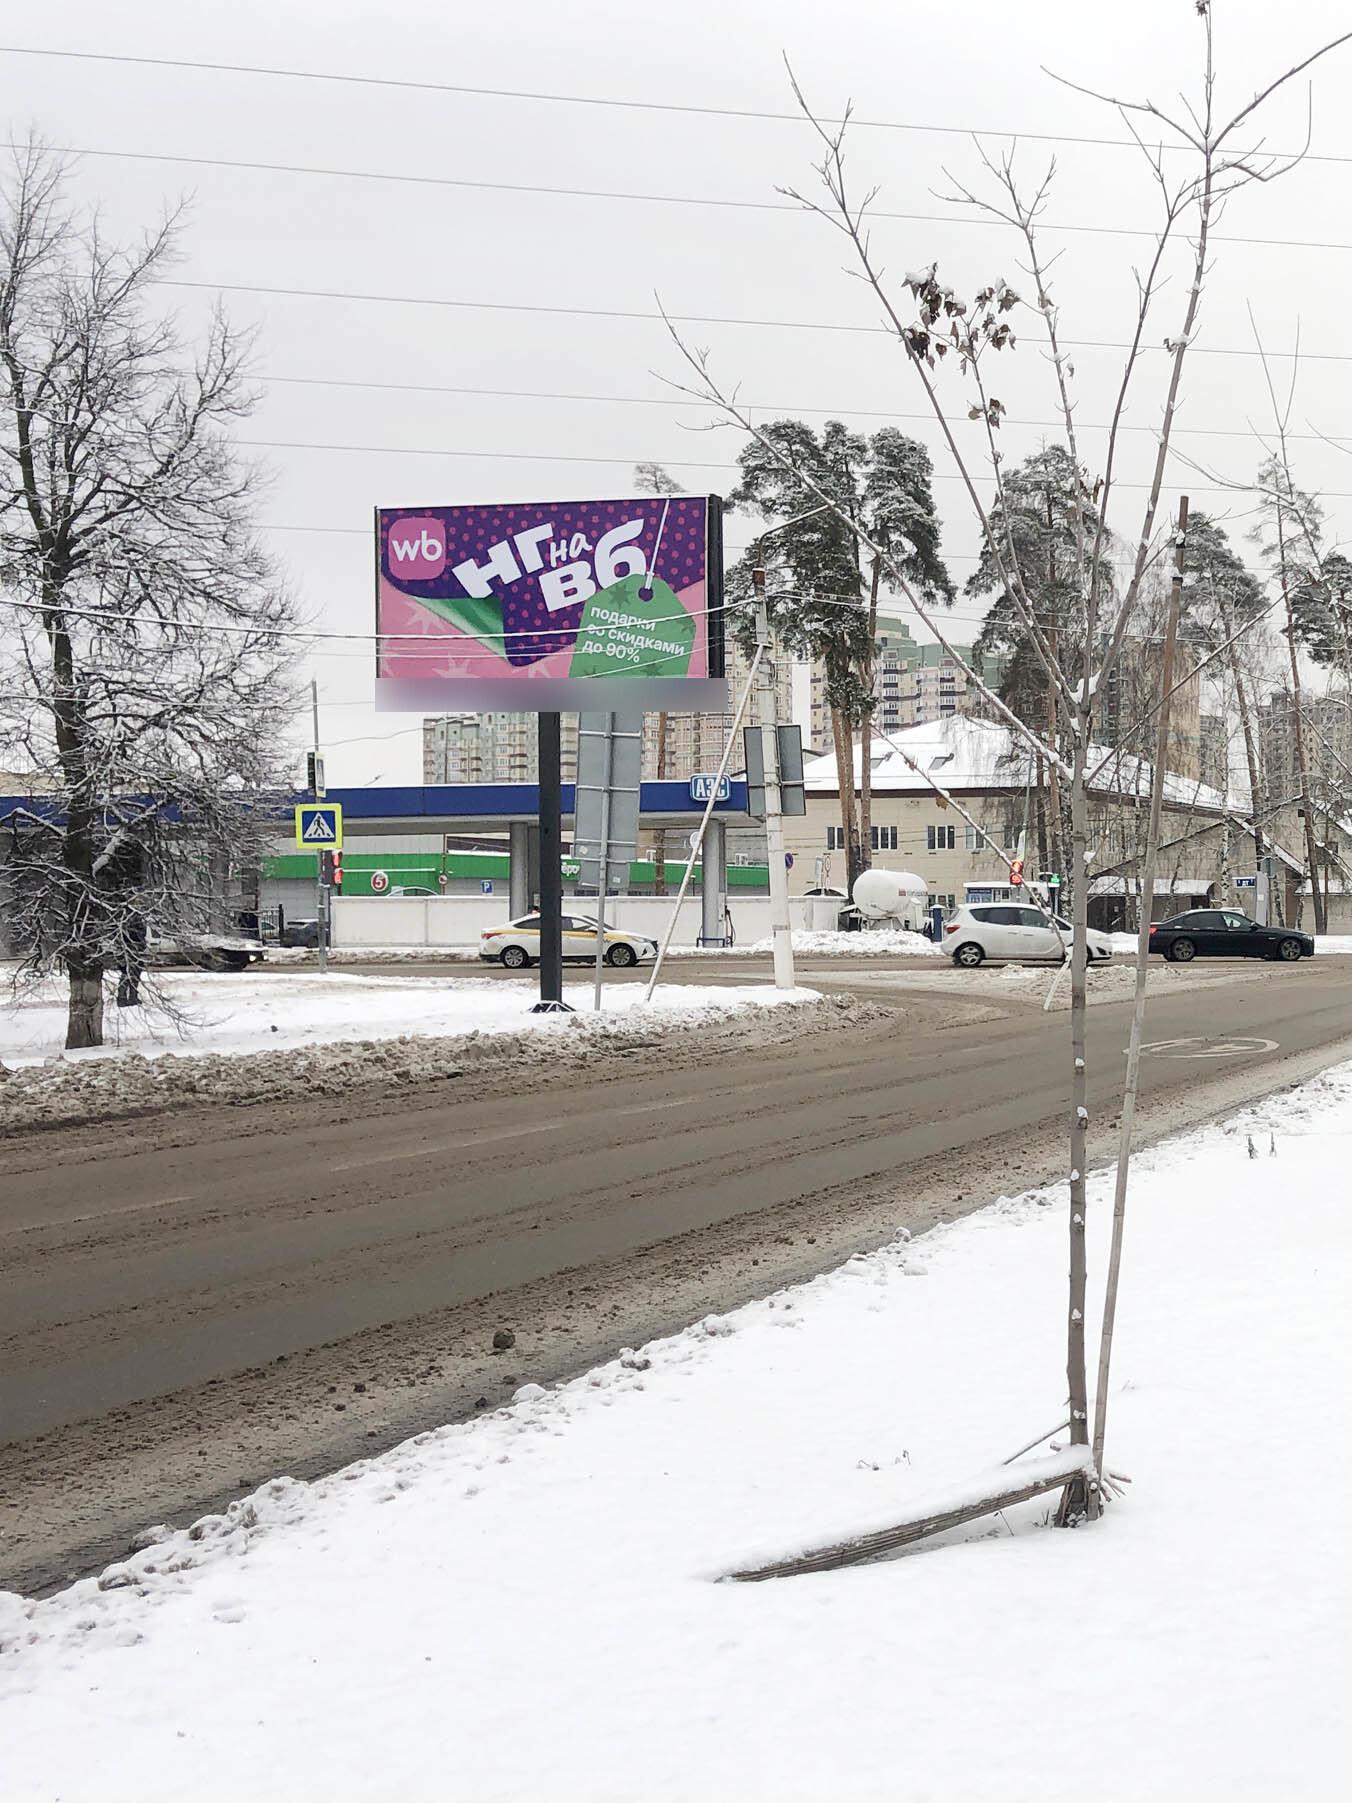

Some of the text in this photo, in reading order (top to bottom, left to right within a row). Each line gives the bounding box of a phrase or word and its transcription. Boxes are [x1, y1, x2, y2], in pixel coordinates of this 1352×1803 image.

[392, 530, 442, 562] wb
[550, 532, 593, 567] на
[590, 606, 656, 632] подарки
[582, 641, 640, 663] до 90%
[608, 629, 685, 655] скидками
